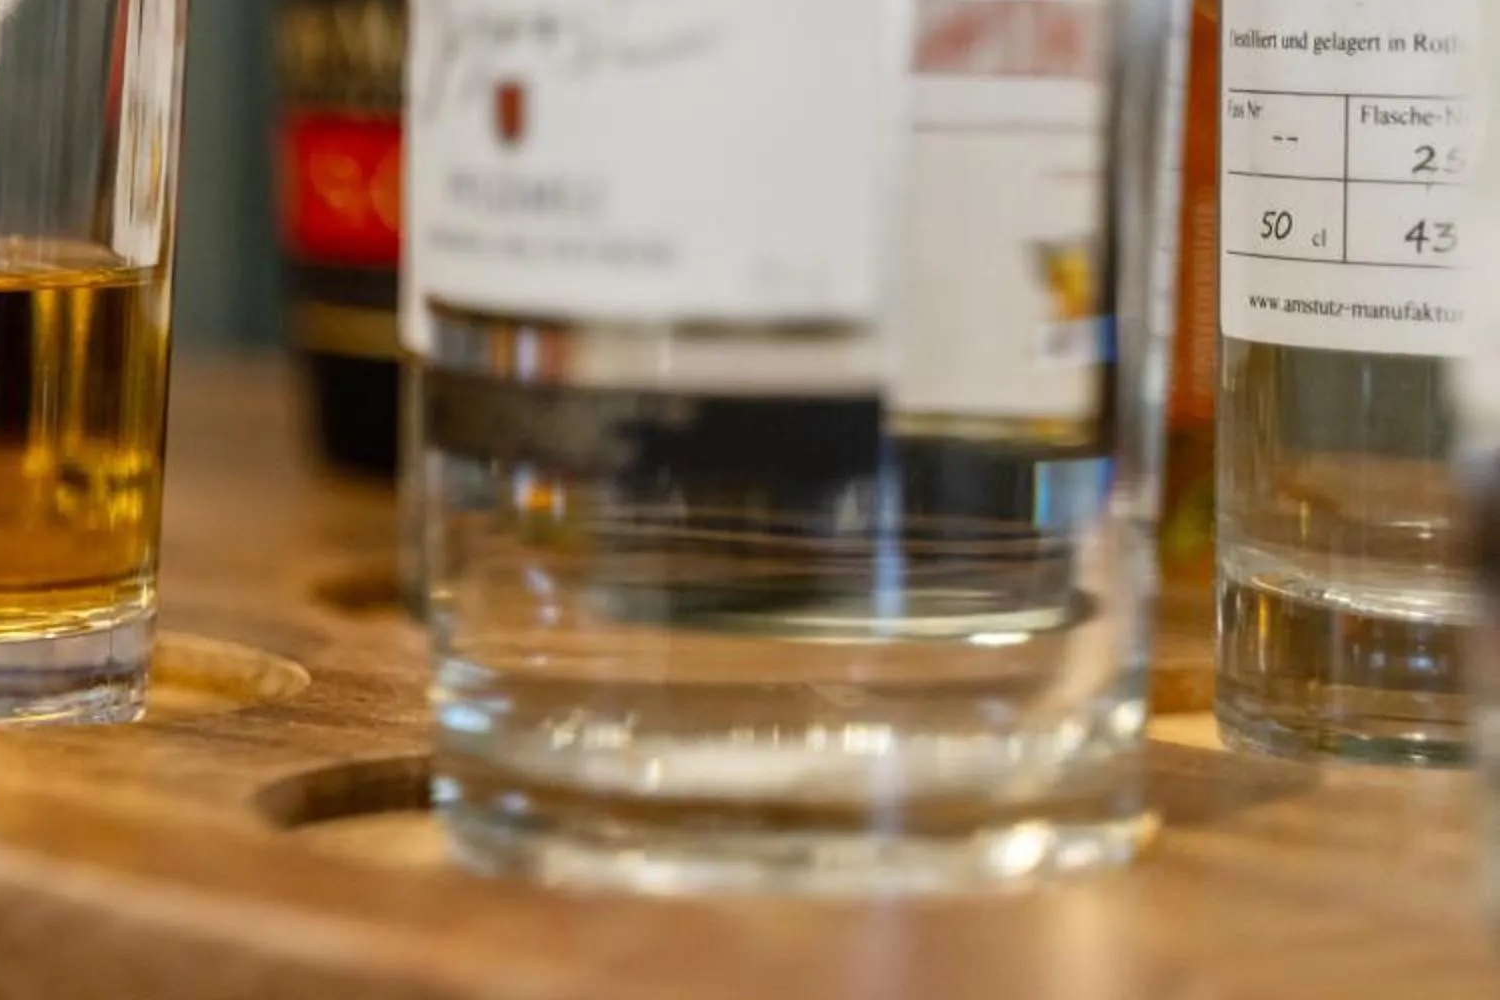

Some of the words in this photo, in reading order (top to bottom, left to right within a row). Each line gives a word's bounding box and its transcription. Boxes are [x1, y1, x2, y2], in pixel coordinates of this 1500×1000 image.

[1281, 31, 1308, 50] und
[1312, 31, 1380, 56] gelagert
[1387, 36, 1406, 52] in
[1260, 211, 1294, 240] 50
[1311, 229, 1327, 248] cl
[1404, 220, 1459, 254] 43
